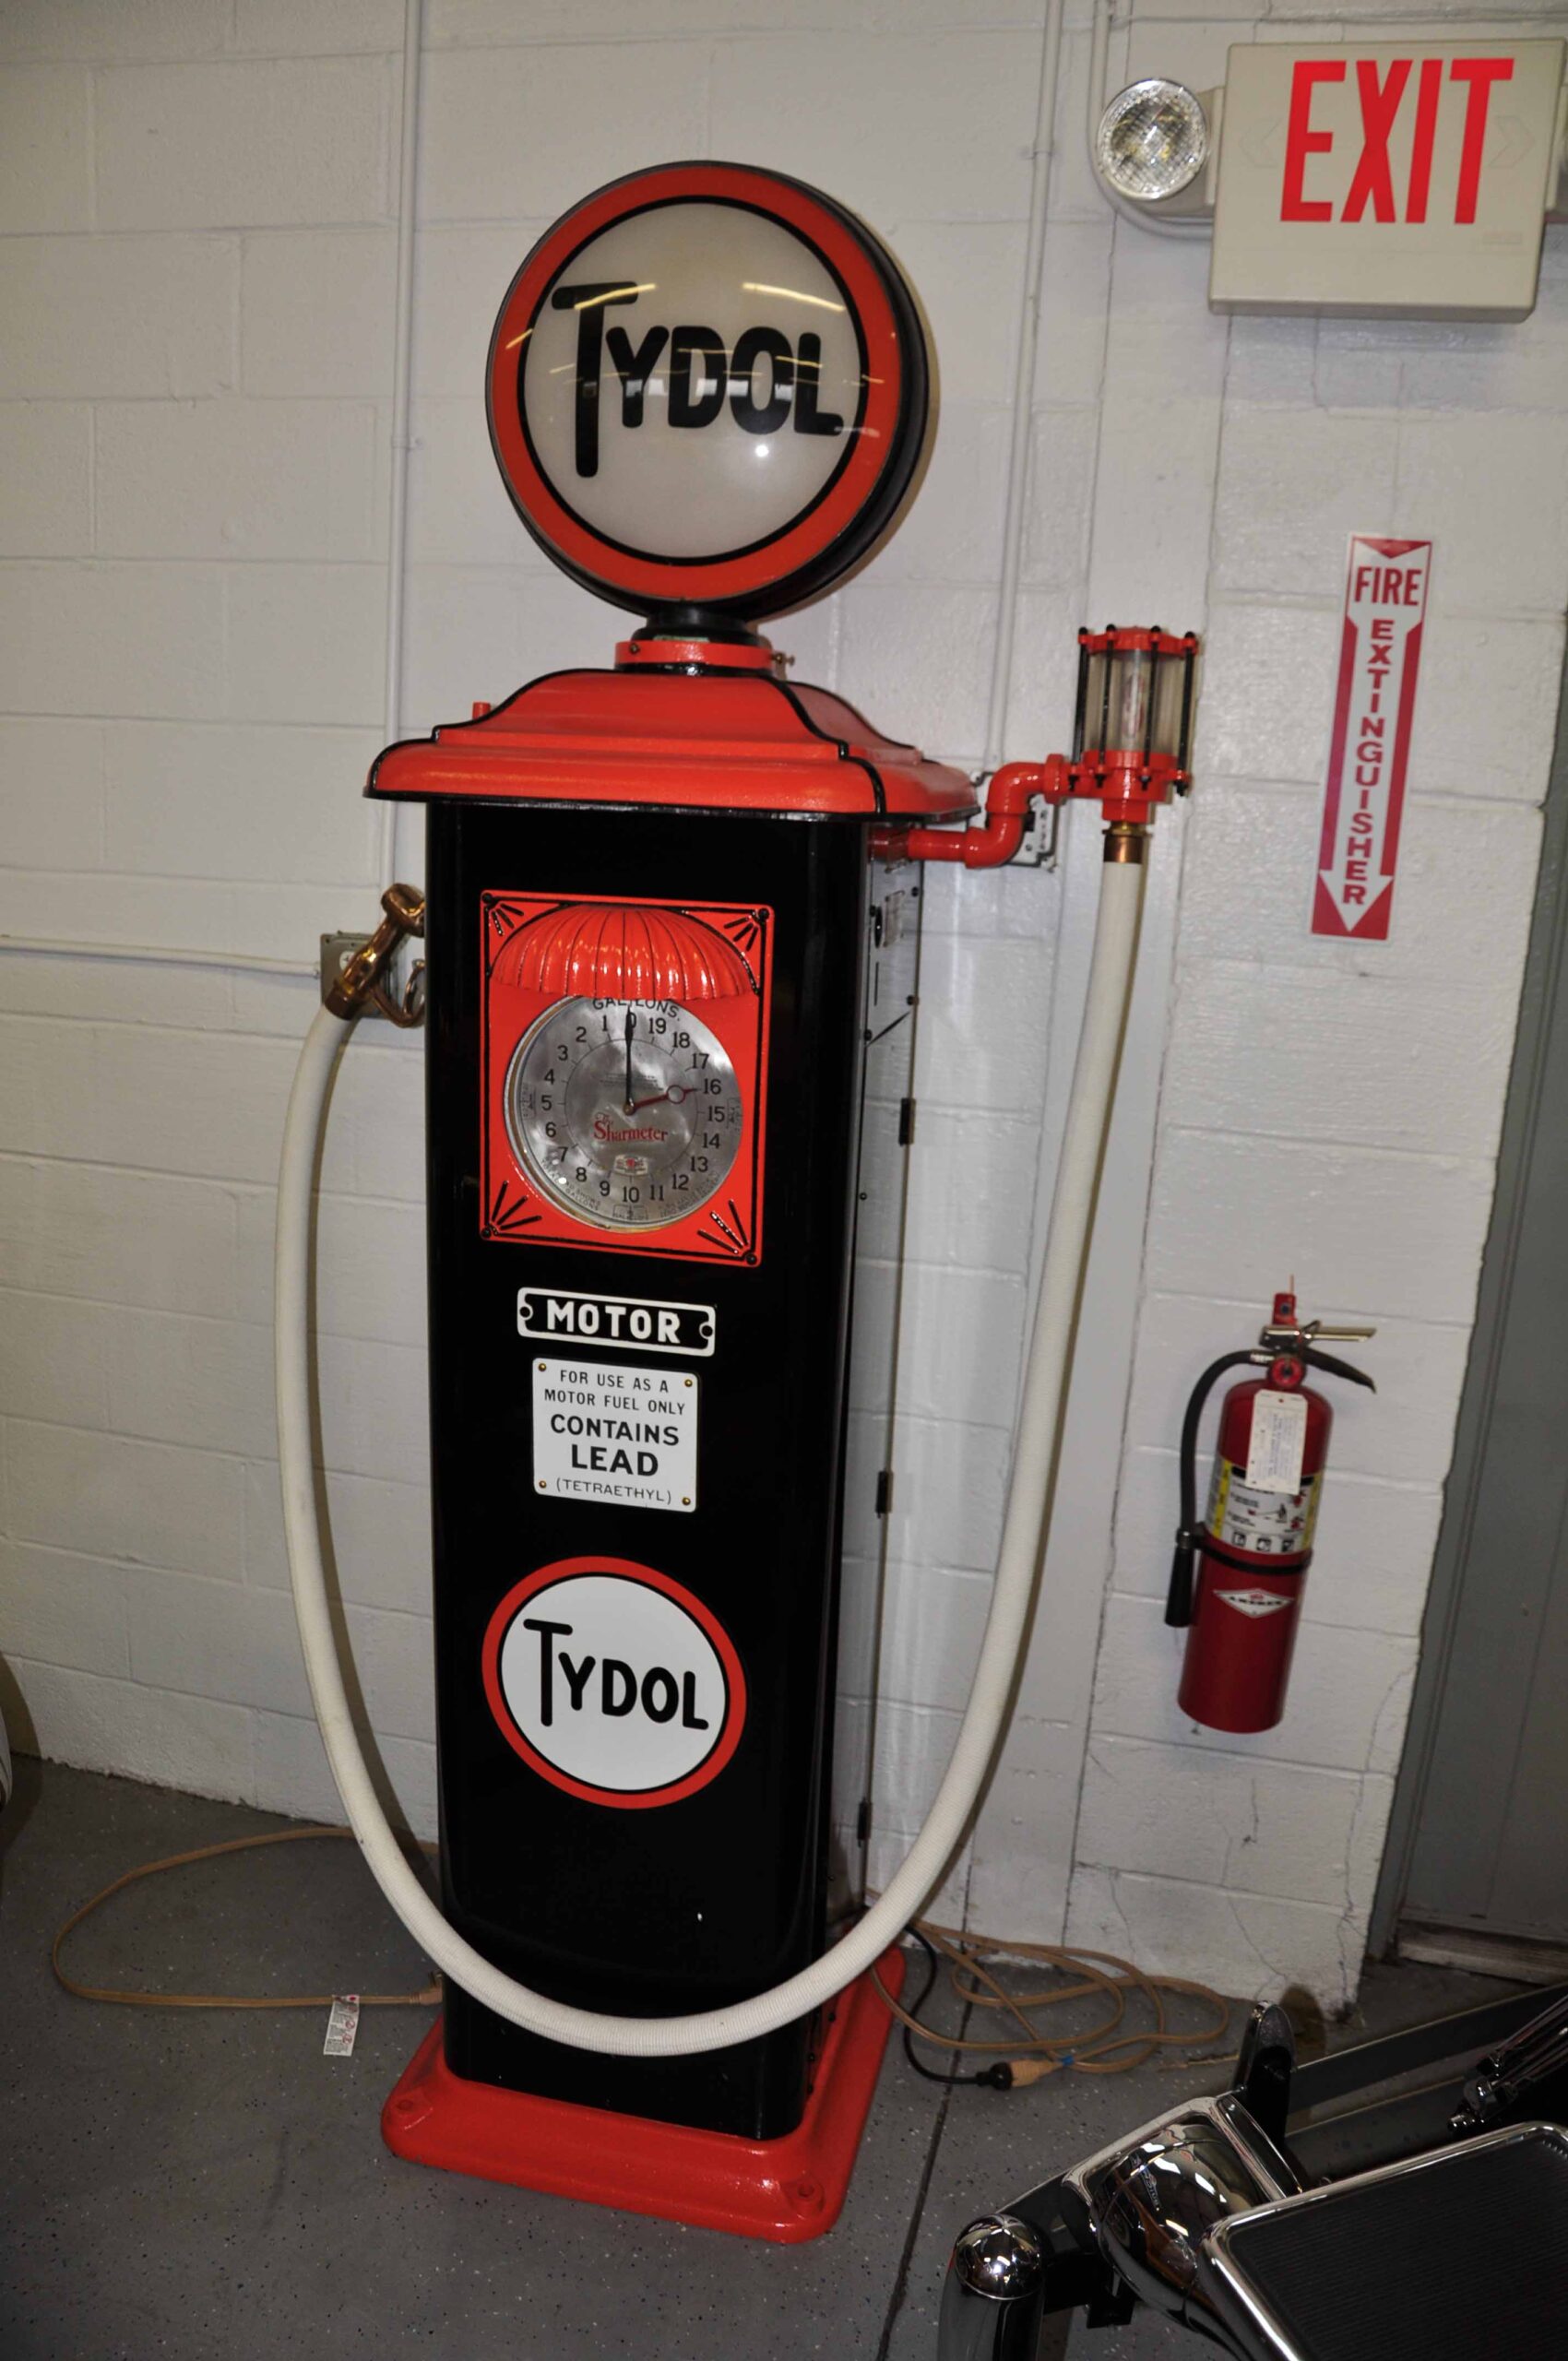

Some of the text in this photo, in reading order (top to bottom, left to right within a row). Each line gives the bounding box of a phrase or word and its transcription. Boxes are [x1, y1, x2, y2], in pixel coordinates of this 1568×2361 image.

[1279, 57, 1515, 224] EXIT
[551, 280, 844, 478] TYDOL
[1354, 565, 1422, 607] FIRE
[1342, 619, 1395, 906] EXTINGUISHER
[602, 1015, 608, 1031] 1
[648, 1017, 666, 1034] 19
[576, 1026, 587, 1042] 2
[672, 1031, 690, 1048] 18
[557, 1045, 568, 1061] 3
[692, 1053, 709, 1069] 17
[544, 1068, 555, 1085] 4
[703, 1078, 721, 1095] 16
[540, 1095, 552, 1110] 5
[707, 1106, 725, 1122] 15
[545, 1122, 556, 1137] 6
[593, 1120, 668, 1142] Sharmeter
[702, 1133, 720, 1149] 14
[558, 1147, 568, 1162] 7
[690, 1157, 708, 1172] 13
[576, 1167, 588, 1181] 8
[671, 1173, 689, 1191] 12
[600, 1180, 611, 1196] 9
[622, 1186, 640, 1203] 10
[650, 1184, 664, 1202] 11
[546, 1299, 681, 1344] MOTOR
[560, 1370, 669, 1393] FOR USE AS A
[544, 1389, 685, 1416] MOTOR FUEL ONLY
[550, 1414, 679, 1446] CONTAINS
[571, 1443, 659, 1477] LEAD
[556, 1477, 671, 1505] (TETRAETHYL)
[523, 1618, 709, 1730] TYDOL
